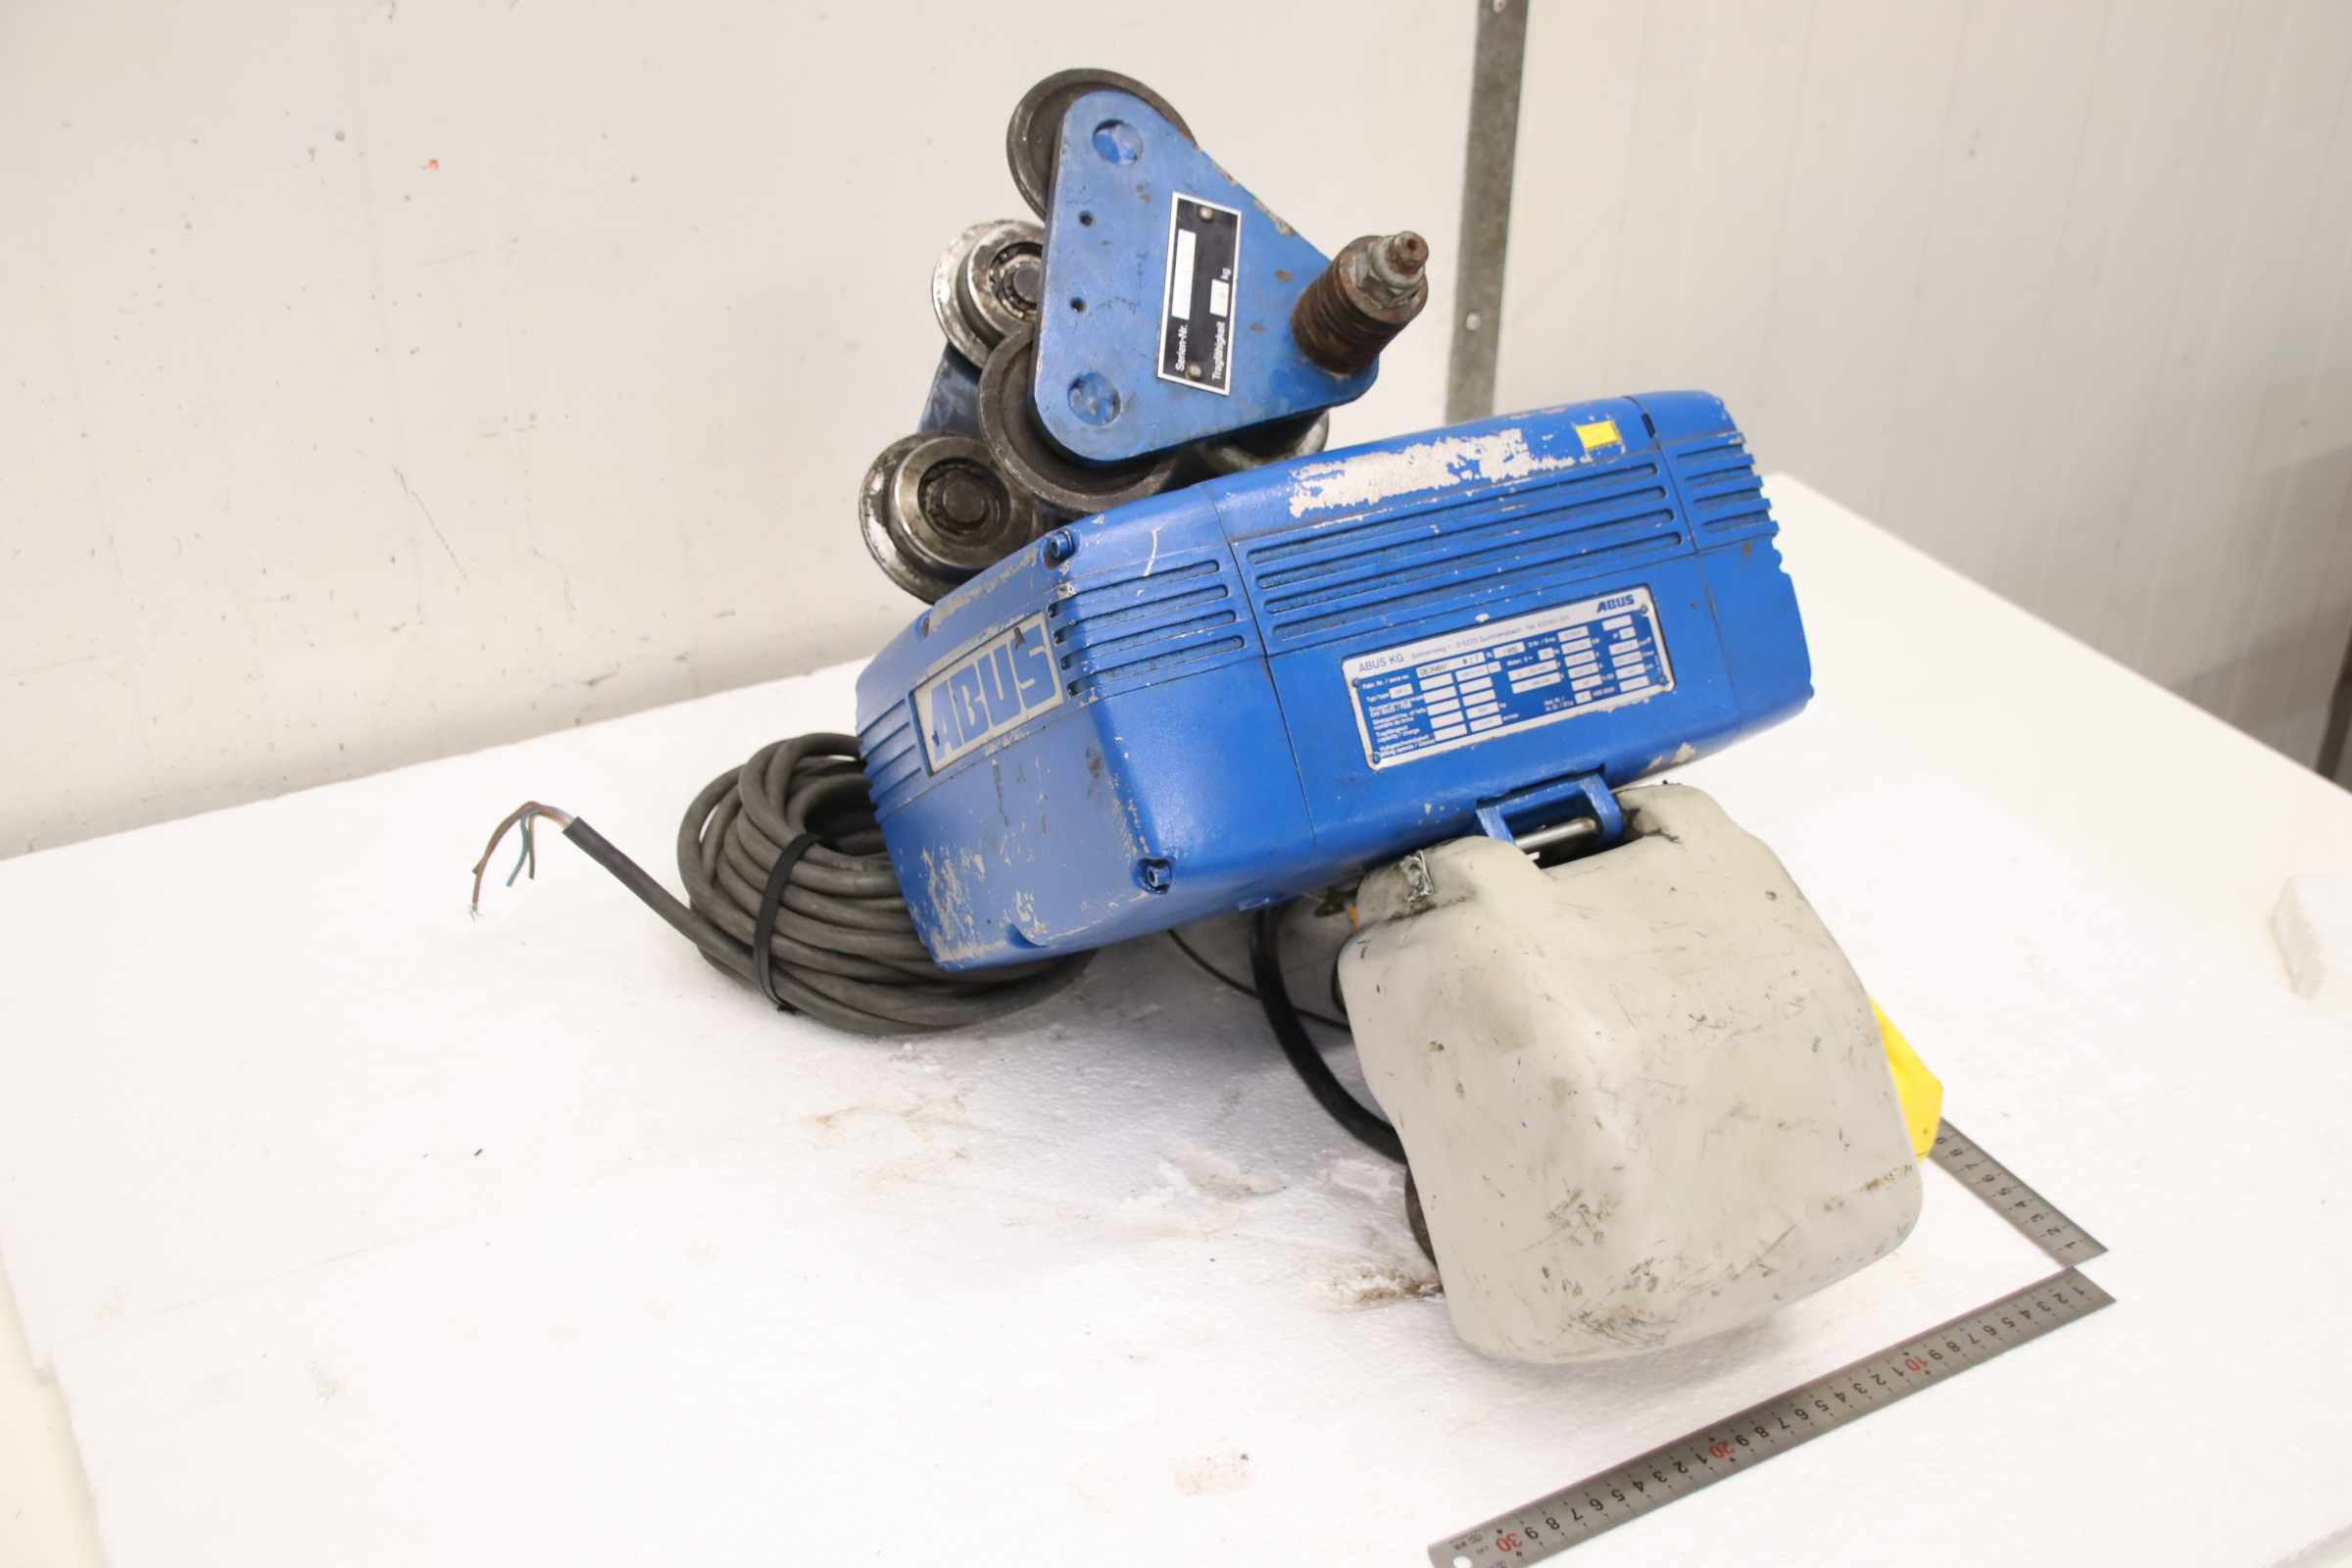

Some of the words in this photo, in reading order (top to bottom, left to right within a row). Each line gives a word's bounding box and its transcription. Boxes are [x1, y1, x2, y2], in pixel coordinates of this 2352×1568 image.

[1220, 268, 1231, 279] kg
[1175, 324, 1188, 371] Serien-Nr.
[1211, 321, 1226, 380] Tragfähigkeit
[1596, 594, 1635, 613] ABUS
[1358, 657, 1388, 673] ABUS
[1389, 653, 1404, 664] KG
[931, 623, 1056, 762] ABUS
[2072, 1286, 2084, 1298] 1
[2054, 1294, 2069, 1304] 2
[2036, 1301, 2050, 1311] 3
[2019, 1309, 2031, 1320] 4
[2001, 1317, 2015, 1329] 5
[1984, 1325, 1997, 1337] 6
[1968, 1333, 1980, 1345] 7
[1946, 1341, 1960, 1352] 8
[1929, 1348, 1942, 1360] 9
[1905, 1355, 1929, 1372] 10
[1892, 1366, 1903, 1378] 1
[1871, 1374, 1886, 1386] 2
[1853, 1382, 1867, 1395] 3
[1835, 1392, 1846, 1403] 4
[1815, 1399, 1829, 1412] 5
[1794, 1409, 1809, 1420] 6
[1778, 1417, 1789, 1430] 7
[1754, 1426, 1769, 1438] 8
[1735, 1435, 1750, 1446] 9
[1709, 1442, 1735, 1458] 20
[1695, 1454, 1707, 1465] 1
[1673, 1461, 1688, 1474] 2
[1652, 1470, 1668, 1483] 3
[1632, 1481, 1644, 1493] 4
[1611, 1490, 1625, 1501] 5
[1590, 1497, 1603, 1511] 6
[1570, 1508, 1584, 1521] 7
[1545, 1517, 1560, 1530] 8
[1525, 1527, 1539, 1540] 9
[1495, 1533, 1523, 1552] 30
